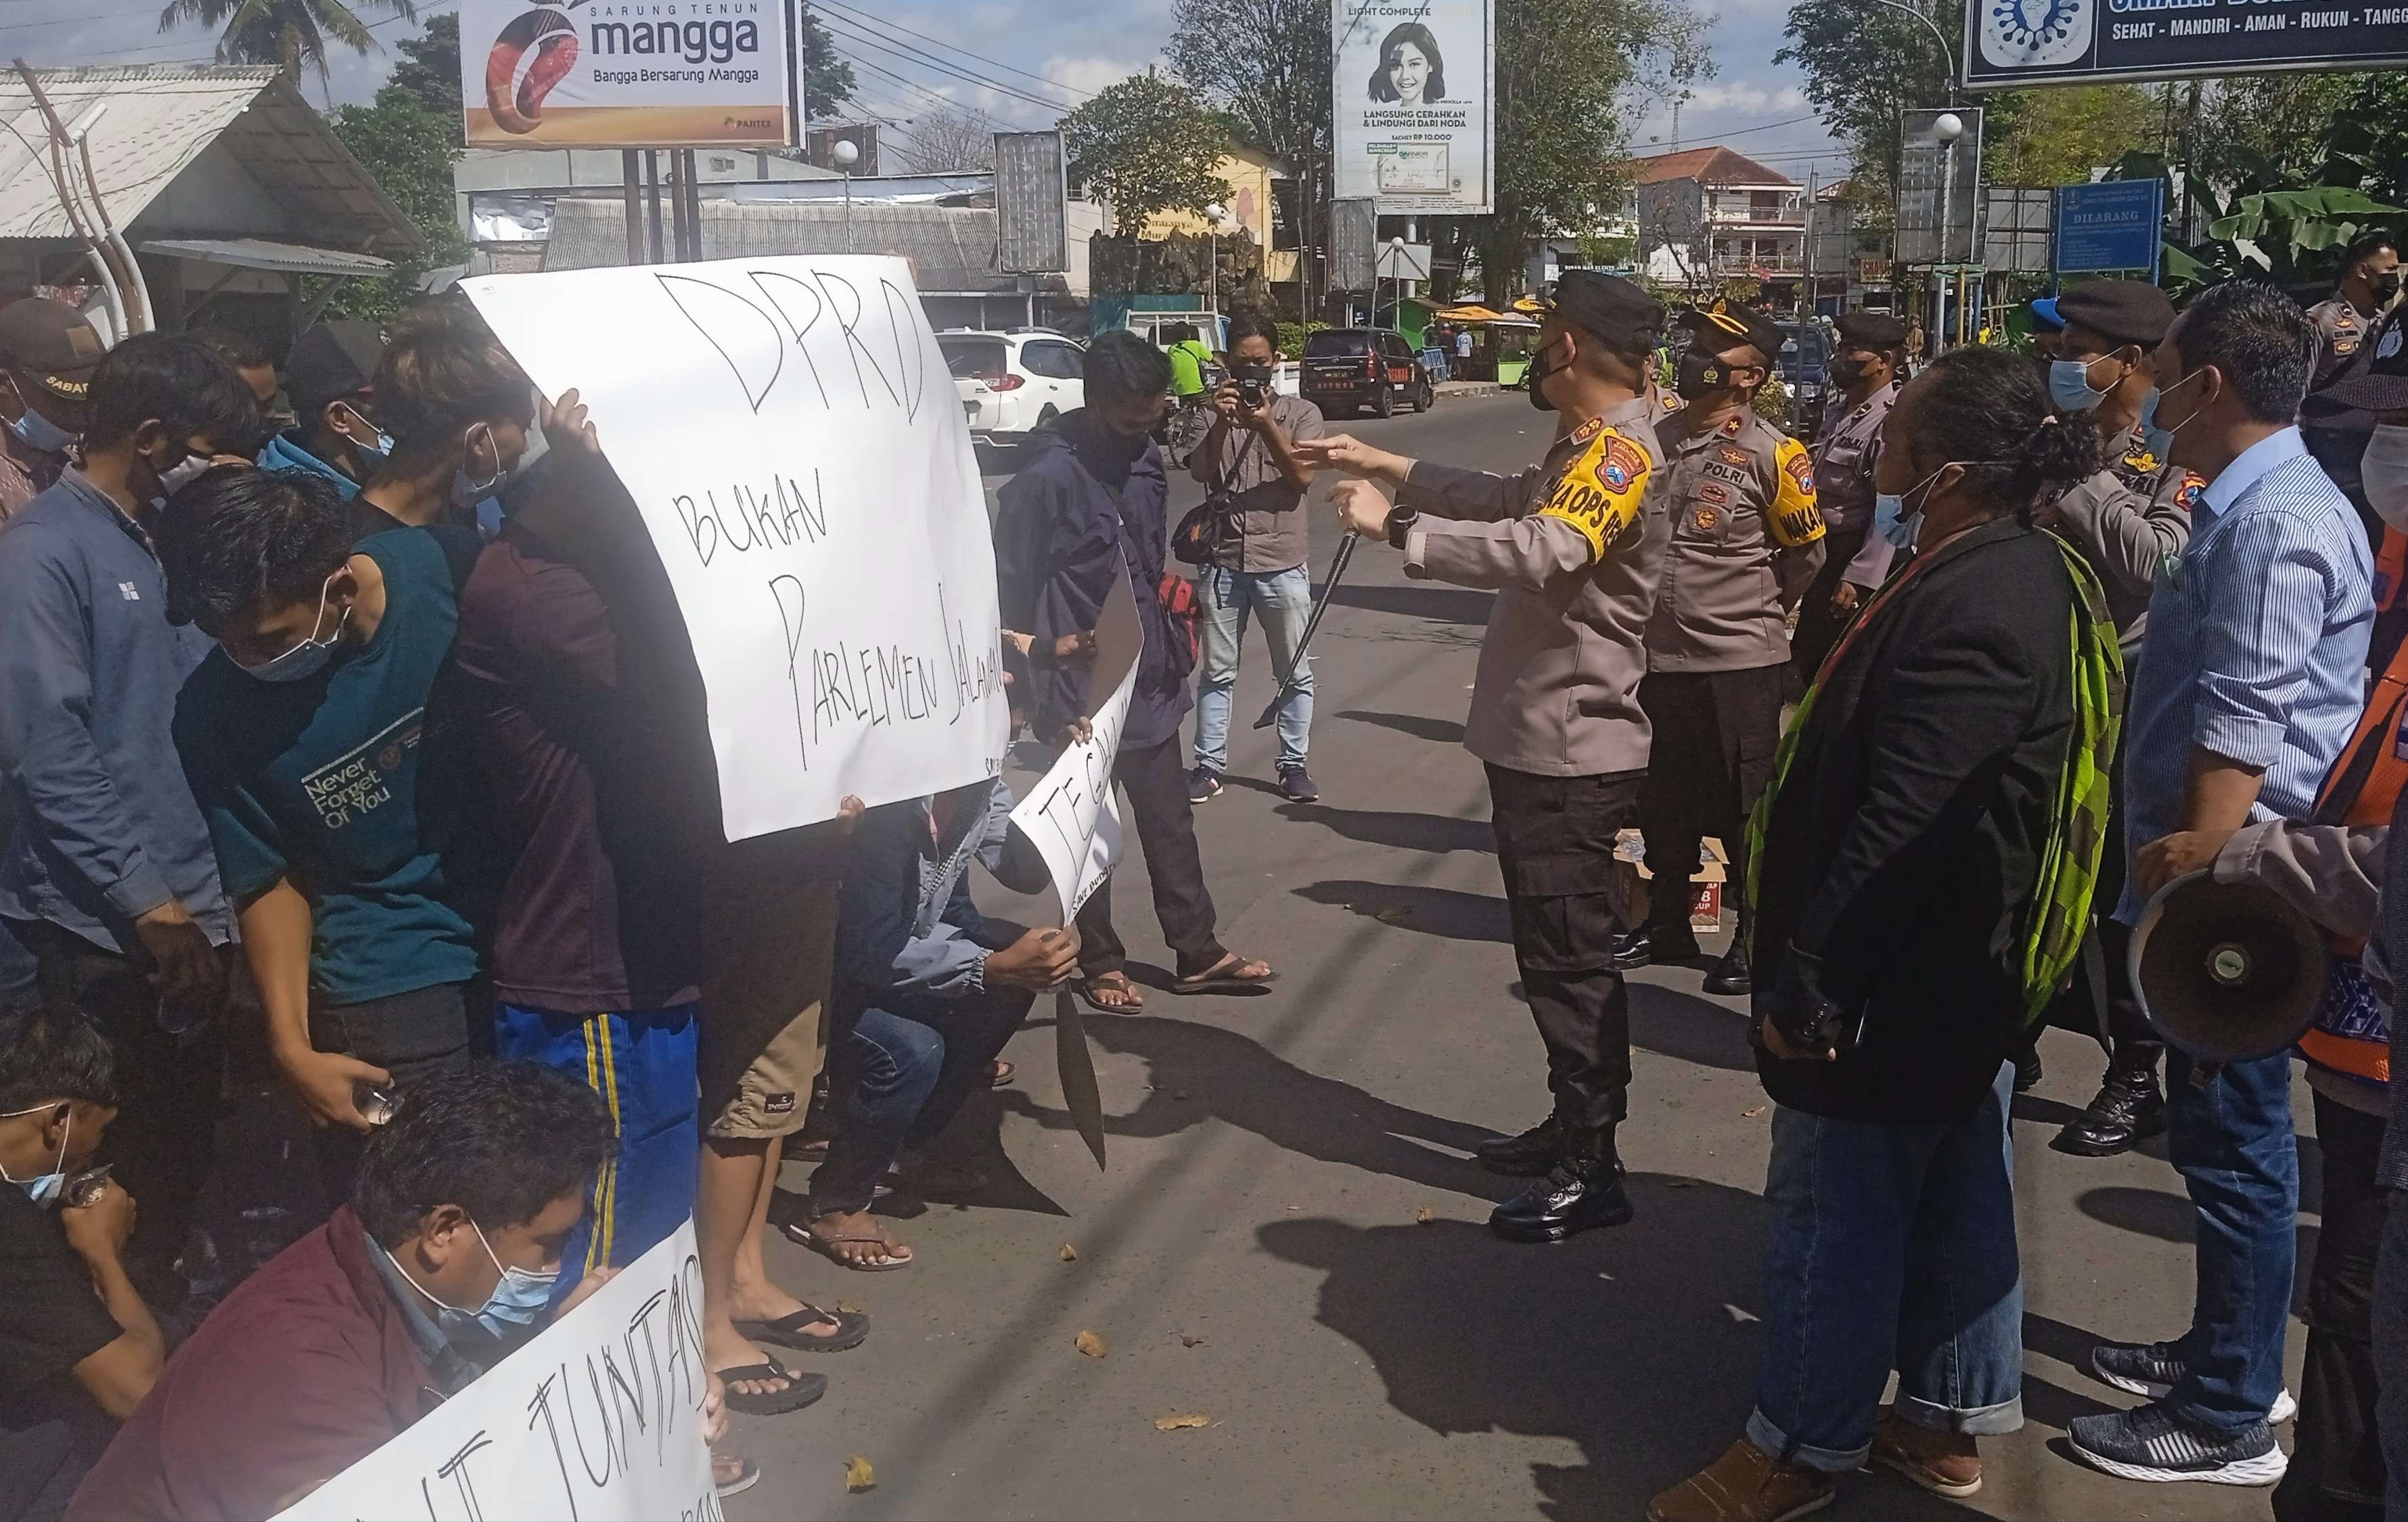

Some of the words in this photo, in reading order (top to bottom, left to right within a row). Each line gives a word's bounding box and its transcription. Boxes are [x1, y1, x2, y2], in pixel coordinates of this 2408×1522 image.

[590, 5, 676, 16] SARUNG
[691, 3, 757, 14] TENUN
[1348, 7, 1377, 16] LIGHT
[1379, 7, 1431, 16] COMPLETE
[2112, 22, 2156, 40] SEHAT
[2171, 18, 2230, 36] MANDIRI
[2244, 14, 2286, 31] AMAN
[2300, 11, 2348, 28] RUKUN
[591, 20, 758, 64] mangga
[594, 70, 637, 84] Bangga
[641, 69, 704, 83] Bersarung
[708, 68, 758, 83] Mangga
[1364, 110, 1413, 118] LANGSUNG
[1416, 110, 1466, 118] CERAHKAN
[2073, 211, 2139, 224] DILARANG
[654, 269, 923, 426] DPRD
[1702, 462, 1746, 484] POLRI
[673, 468, 827, 567] BUKAN
[769, 575, 938, 771] PARLEMEN
[304, 757, 366, 800] Never
[313, 769, 382, 815] Forget
[325, 805, 350, 829] Of
[352, 786, 391, 813] You
[1072, 888, 1087, 914] SAVE
